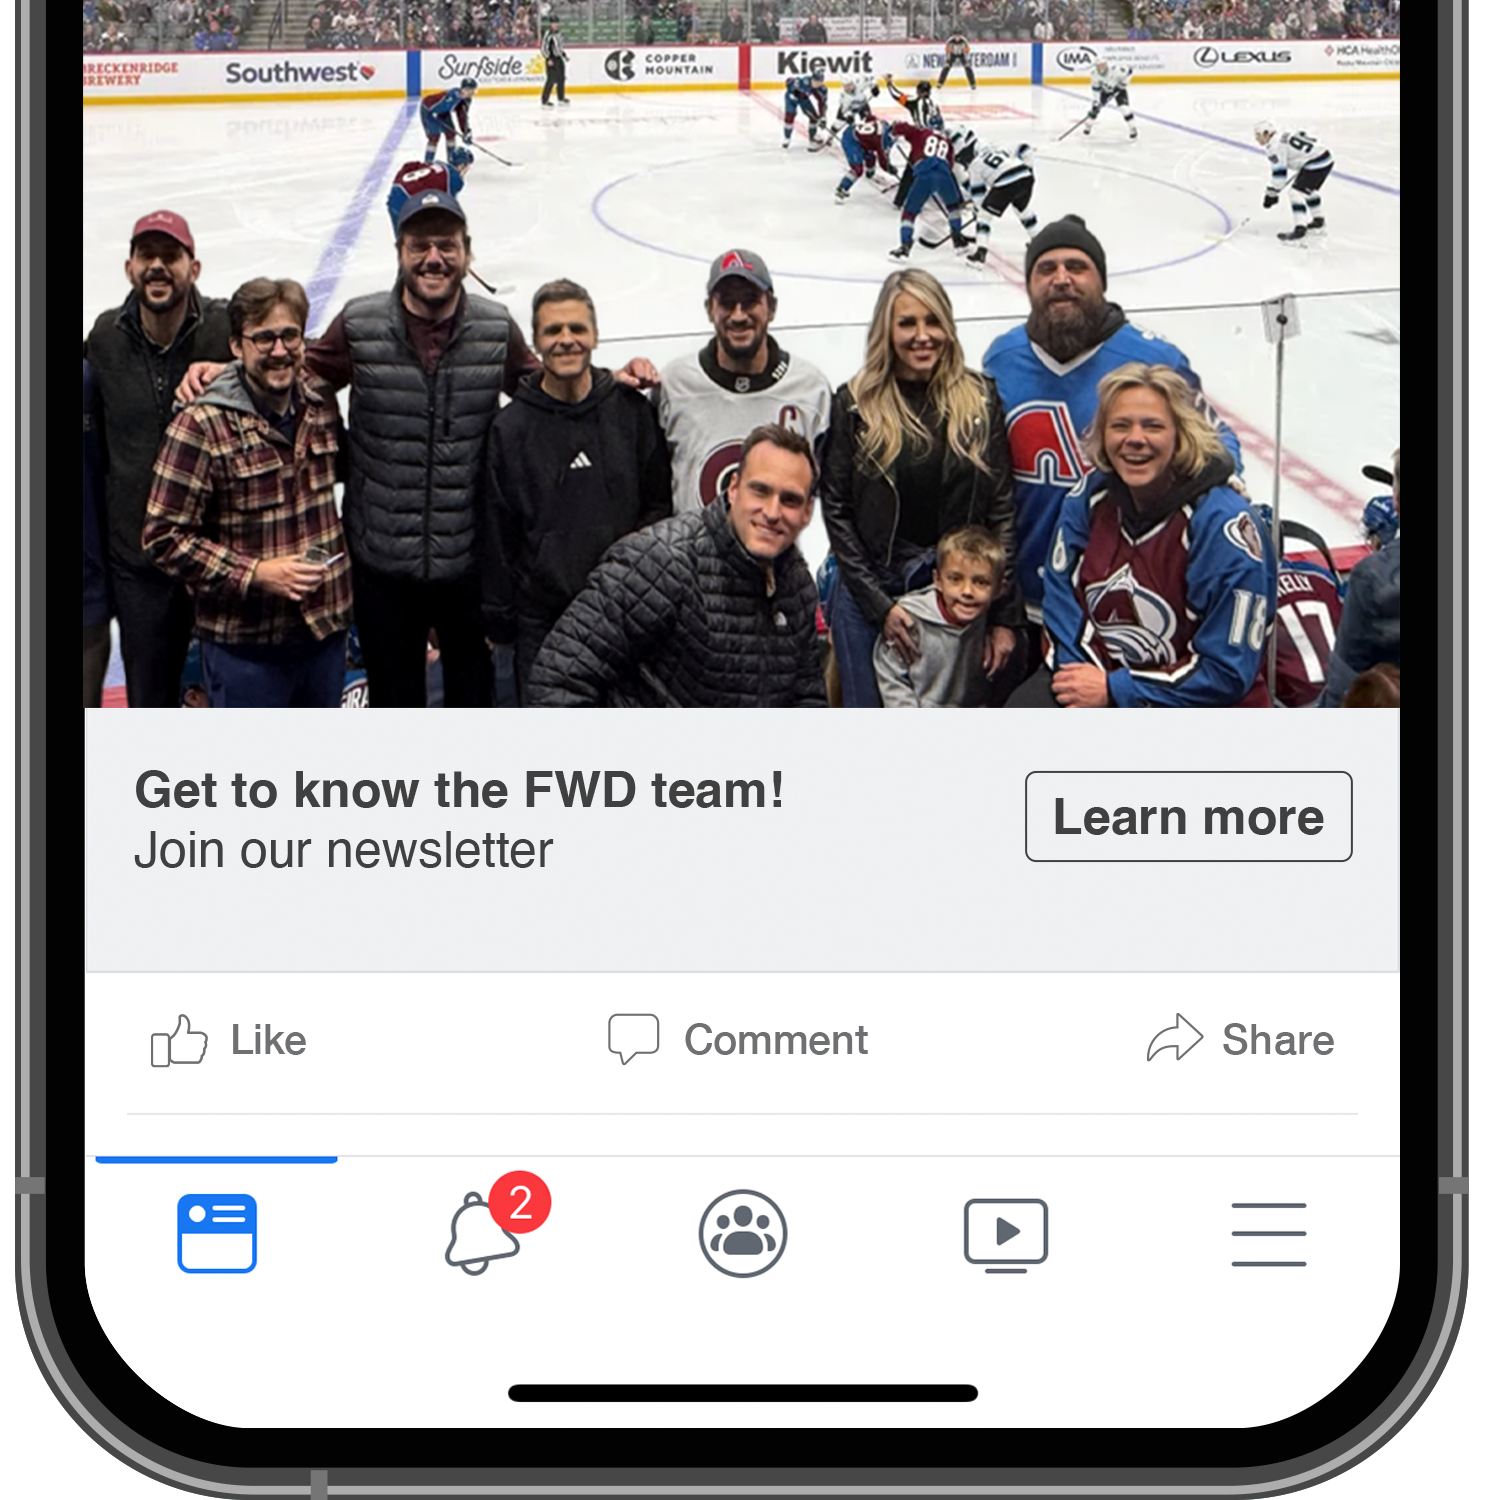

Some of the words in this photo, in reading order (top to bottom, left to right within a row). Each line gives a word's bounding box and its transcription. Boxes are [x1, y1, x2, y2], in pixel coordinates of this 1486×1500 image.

[645, 53, 697, 63] COPPER
[778, 50, 873, 75] Kiewit
[1063, 52, 1092, 64] IMA
[1221, 50, 1291, 63] LEXUS
[1337, 45, 1359, 56] HCA
[225, 61, 358, 84] Southwest
[438, 53, 522, 80] Surfside
[645, 65, 713, 75] MOUNTAIN
[924, 135, 949, 160] 88
[1277, 599, 1337, 683] 17
[136, 770, 217, 808] Get
[231, 773, 277, 808] to
[296, 771, 420, 808] know
[434, 771, 508, 808] the
[526, 771, 636, 807] FWD
[651, 771, 784, 808] team!
[1055, 798, 1187, 836] Learn
[1205, 807, 1325, 836] more
[134, 831, 223, 869] Join
[241, 839, 312, 869] our
[329, 831, 554, 869] newsletter
[232, 1024, 307, 1056] Like
[685, 1023, 869, 1056] Comment
[1222, 1023, 1335, 1056] Share
[509, 1185, 533, 1220] 2
